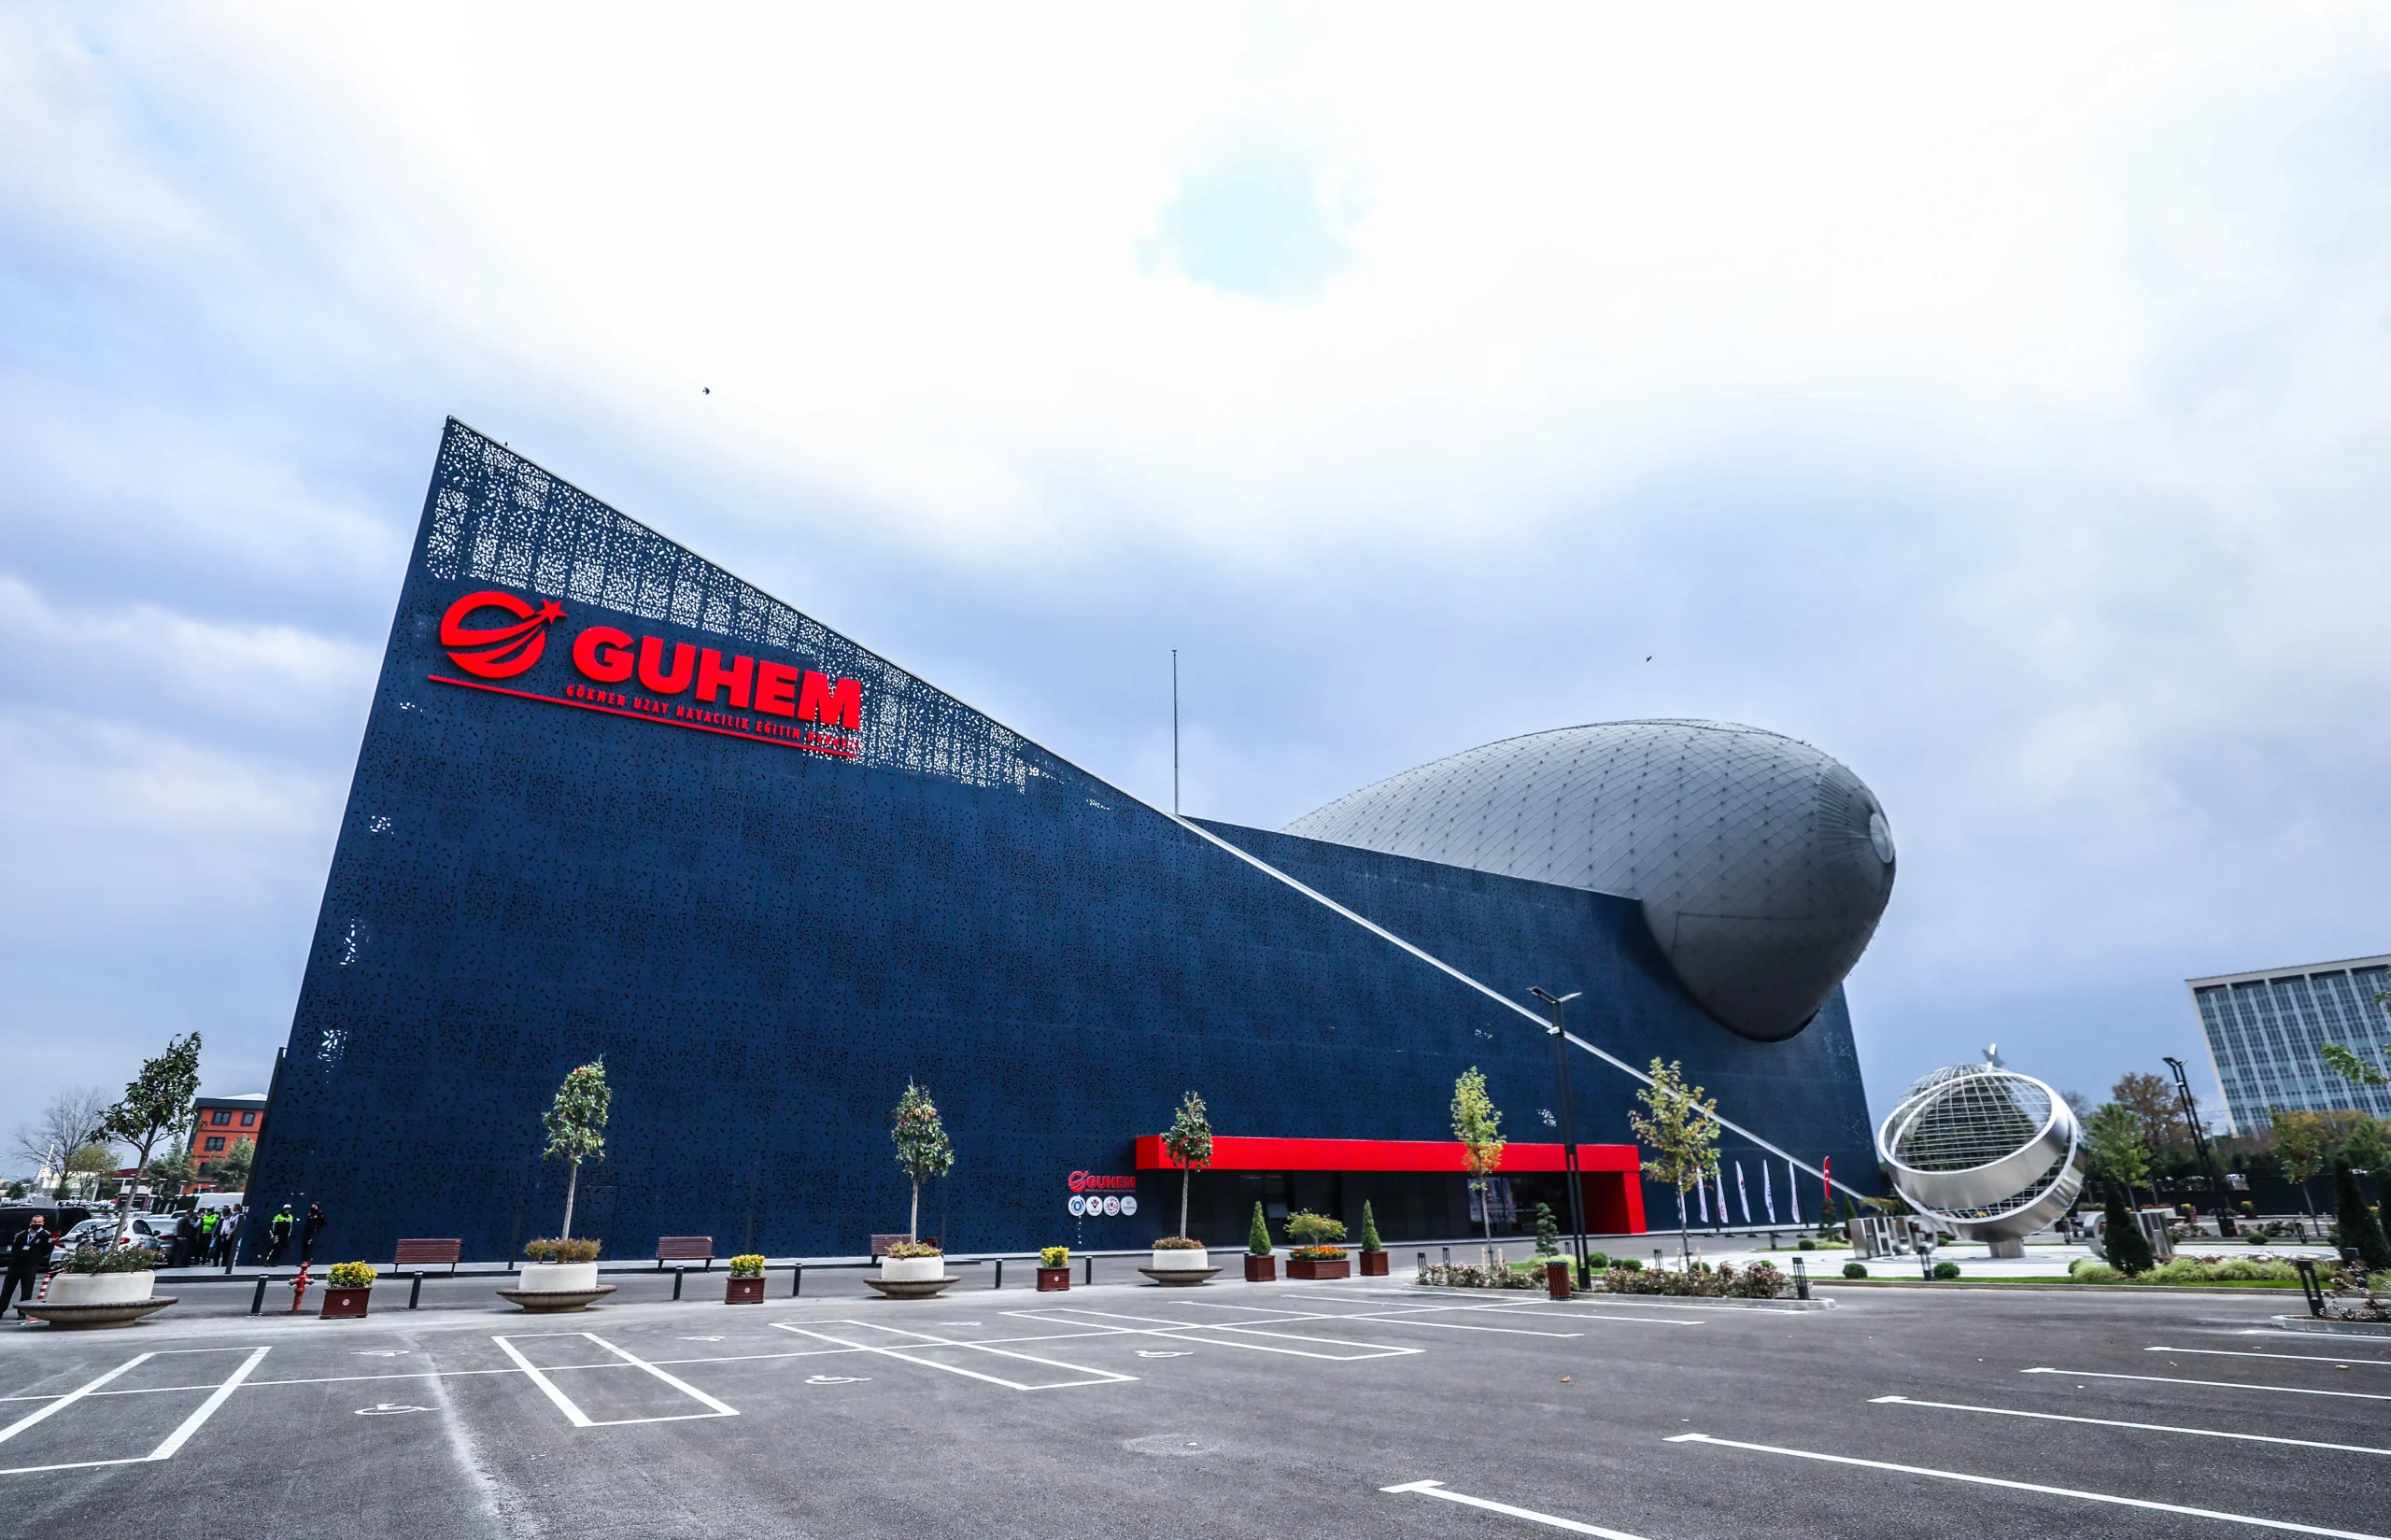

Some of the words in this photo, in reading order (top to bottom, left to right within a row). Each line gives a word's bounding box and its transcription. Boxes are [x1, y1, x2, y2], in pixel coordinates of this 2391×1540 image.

[573, 626, 862, 731] GUHEM
[565, 684, 627, 707] GÖKMEN
[633, 697, 670, 714] UZAY
[675, 705, 750, 730] HAVACILIK
[755, 720, 800, 740] EĞİTİM
[1086, 1175, 1137, 1189] GUHEM
